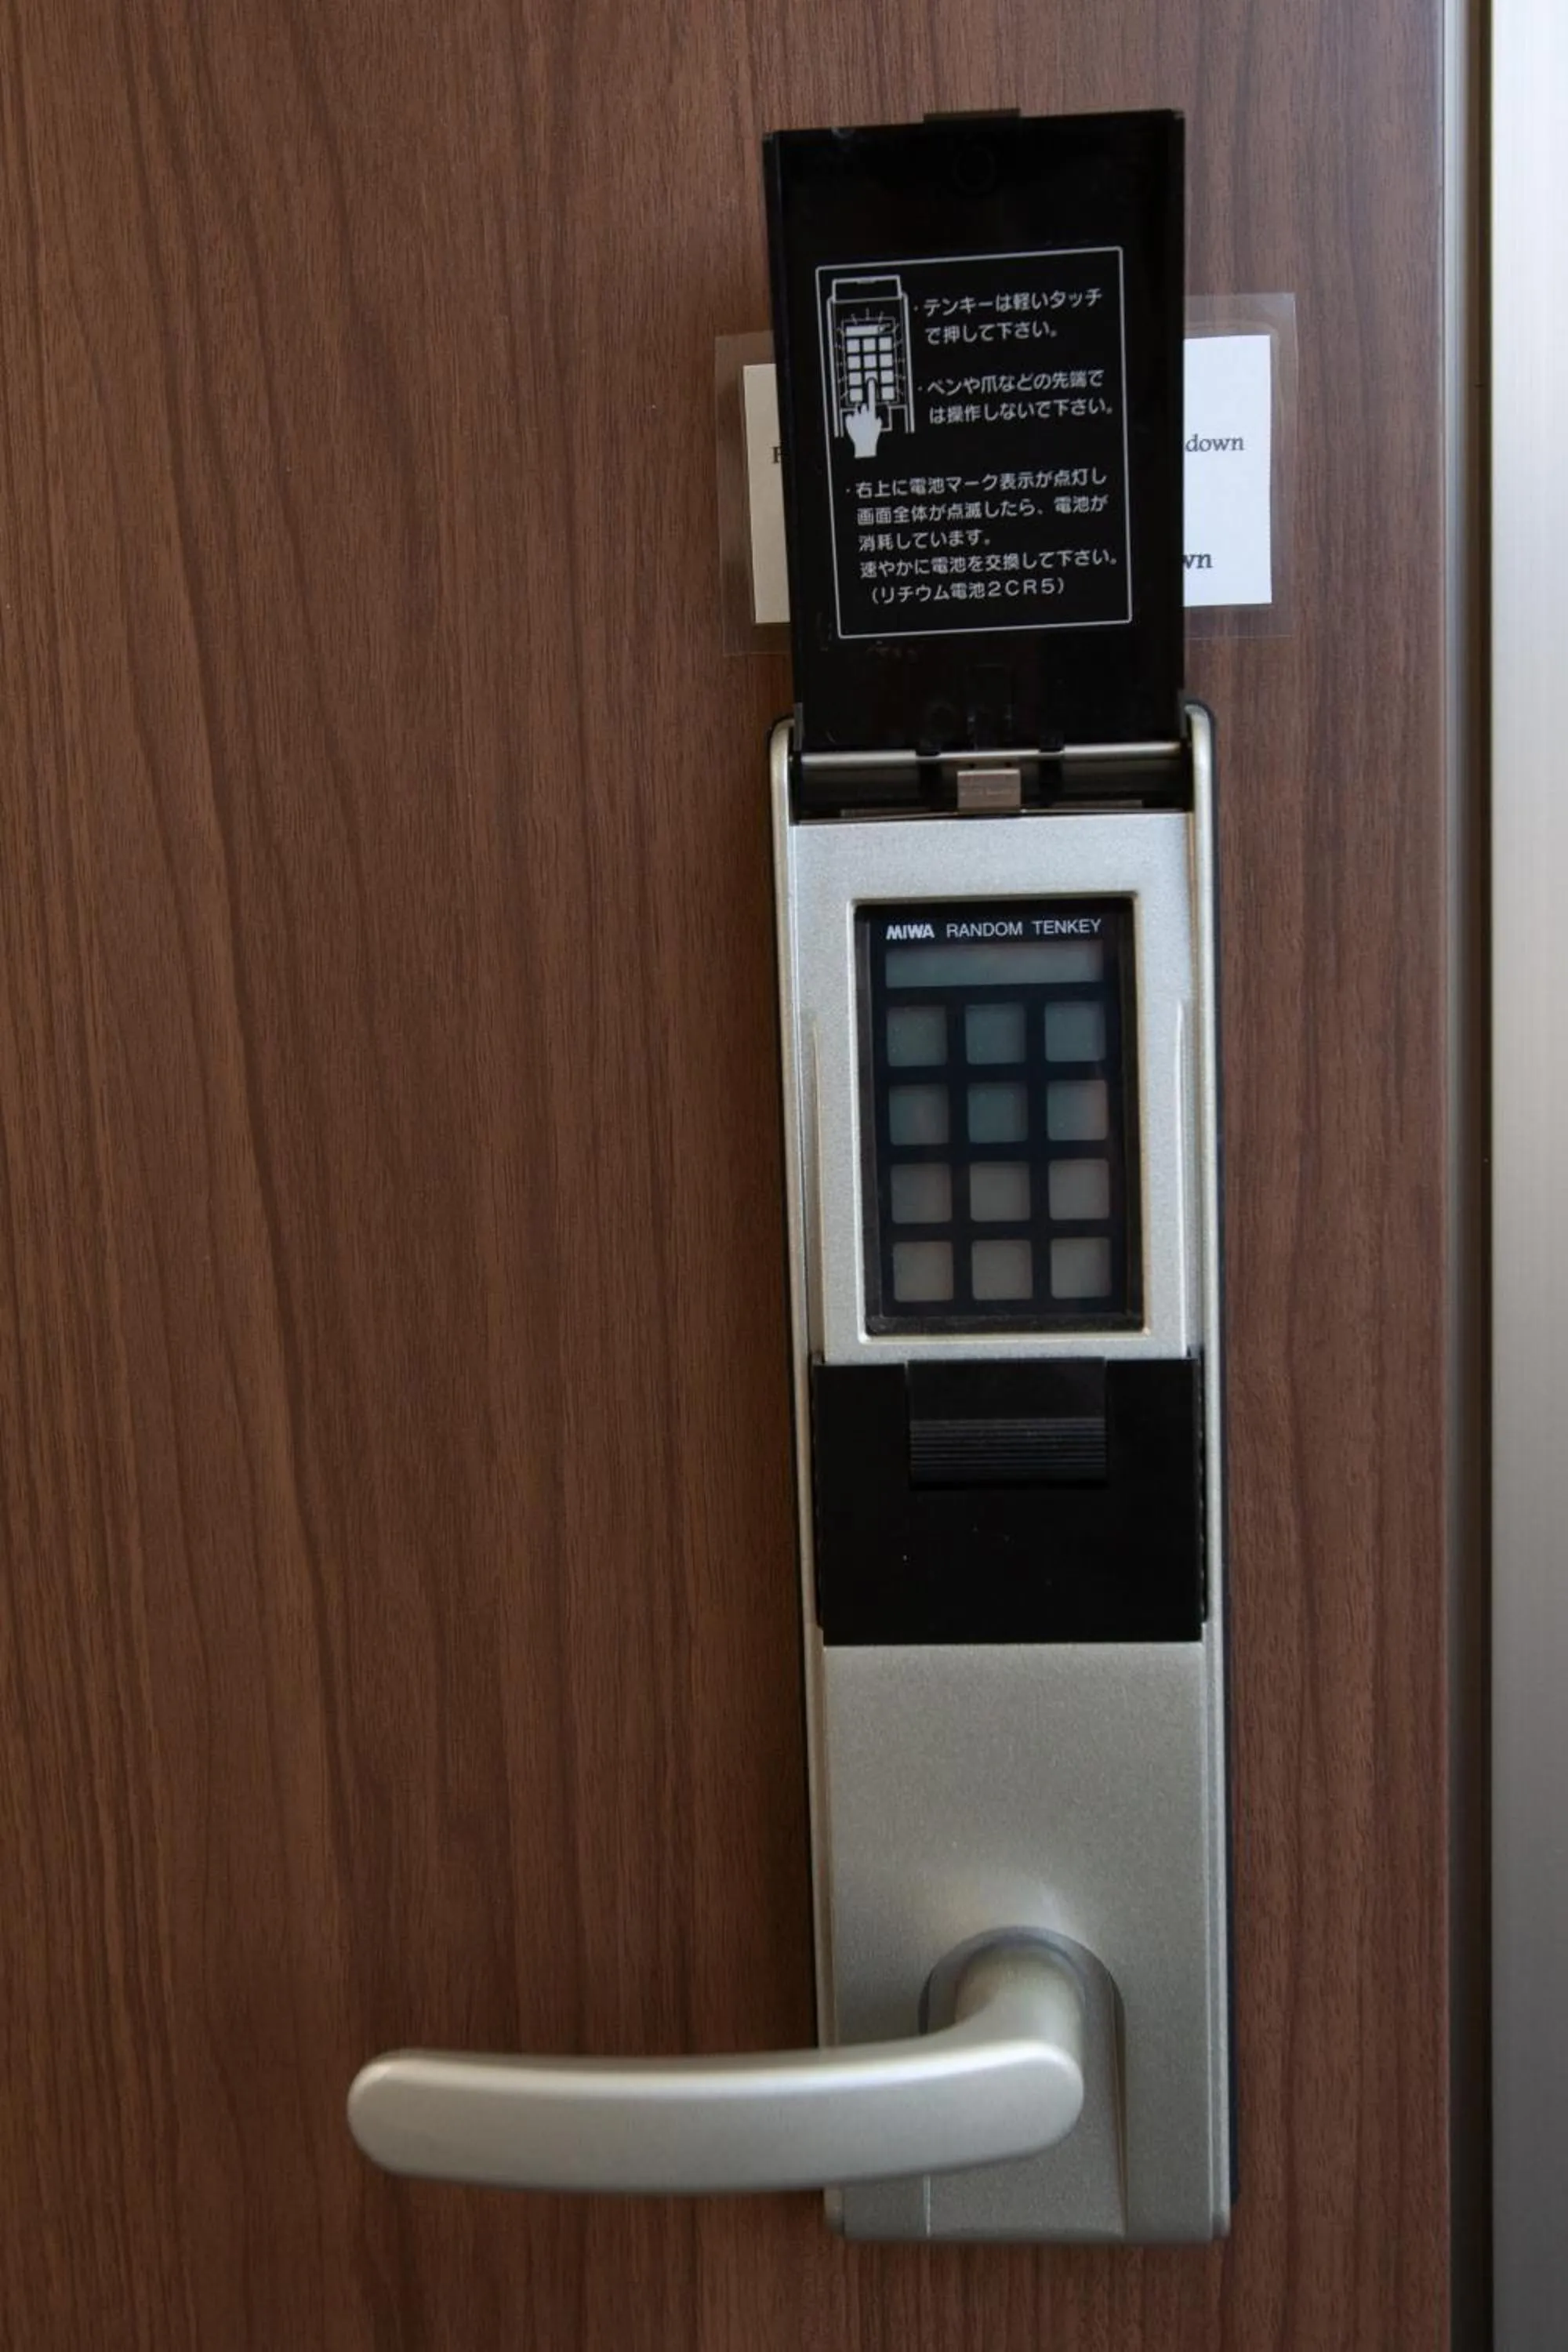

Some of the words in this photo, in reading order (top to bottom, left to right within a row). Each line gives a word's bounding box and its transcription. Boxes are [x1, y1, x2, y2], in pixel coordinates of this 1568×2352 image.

[1185, 433, 1244, 452] down
[886, 924, 935, 940] MIWA
[946, 921, 1022, 938] RANDOM
[1032, 918, 1102, 935] TENKEY
